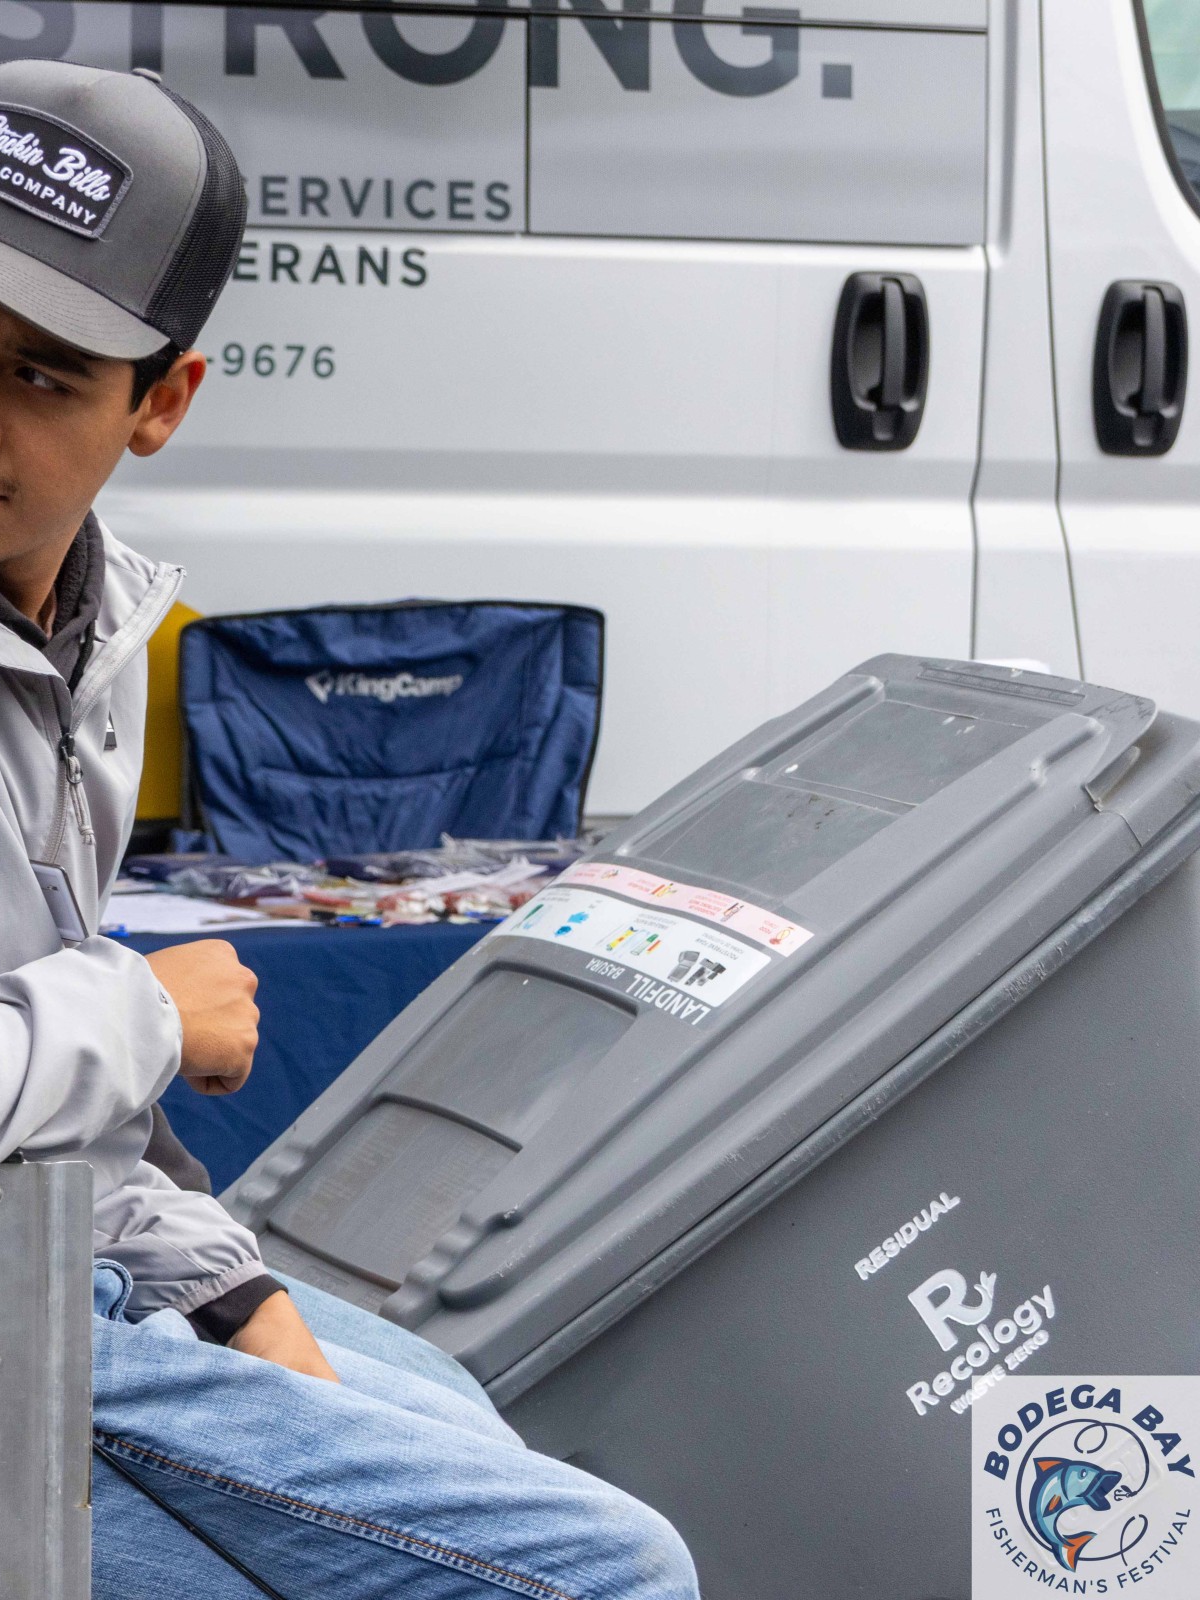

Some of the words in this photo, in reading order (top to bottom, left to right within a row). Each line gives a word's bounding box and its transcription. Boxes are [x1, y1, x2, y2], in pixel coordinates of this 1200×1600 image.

[0, 166, 97, 226] COMPANY
[42, 147, 113, 202] Bills
[243, 175, 512, 222] ERVICES
[585, 958, 625, 981] BASURA
[626, 973, 712, 1026] LANDFILL
[854, 1192, 961, 1281] RESIDUAL
[905, 1284, 1056, 1417] Recology
[1004, 1329, 1050, 1371] ZERO
